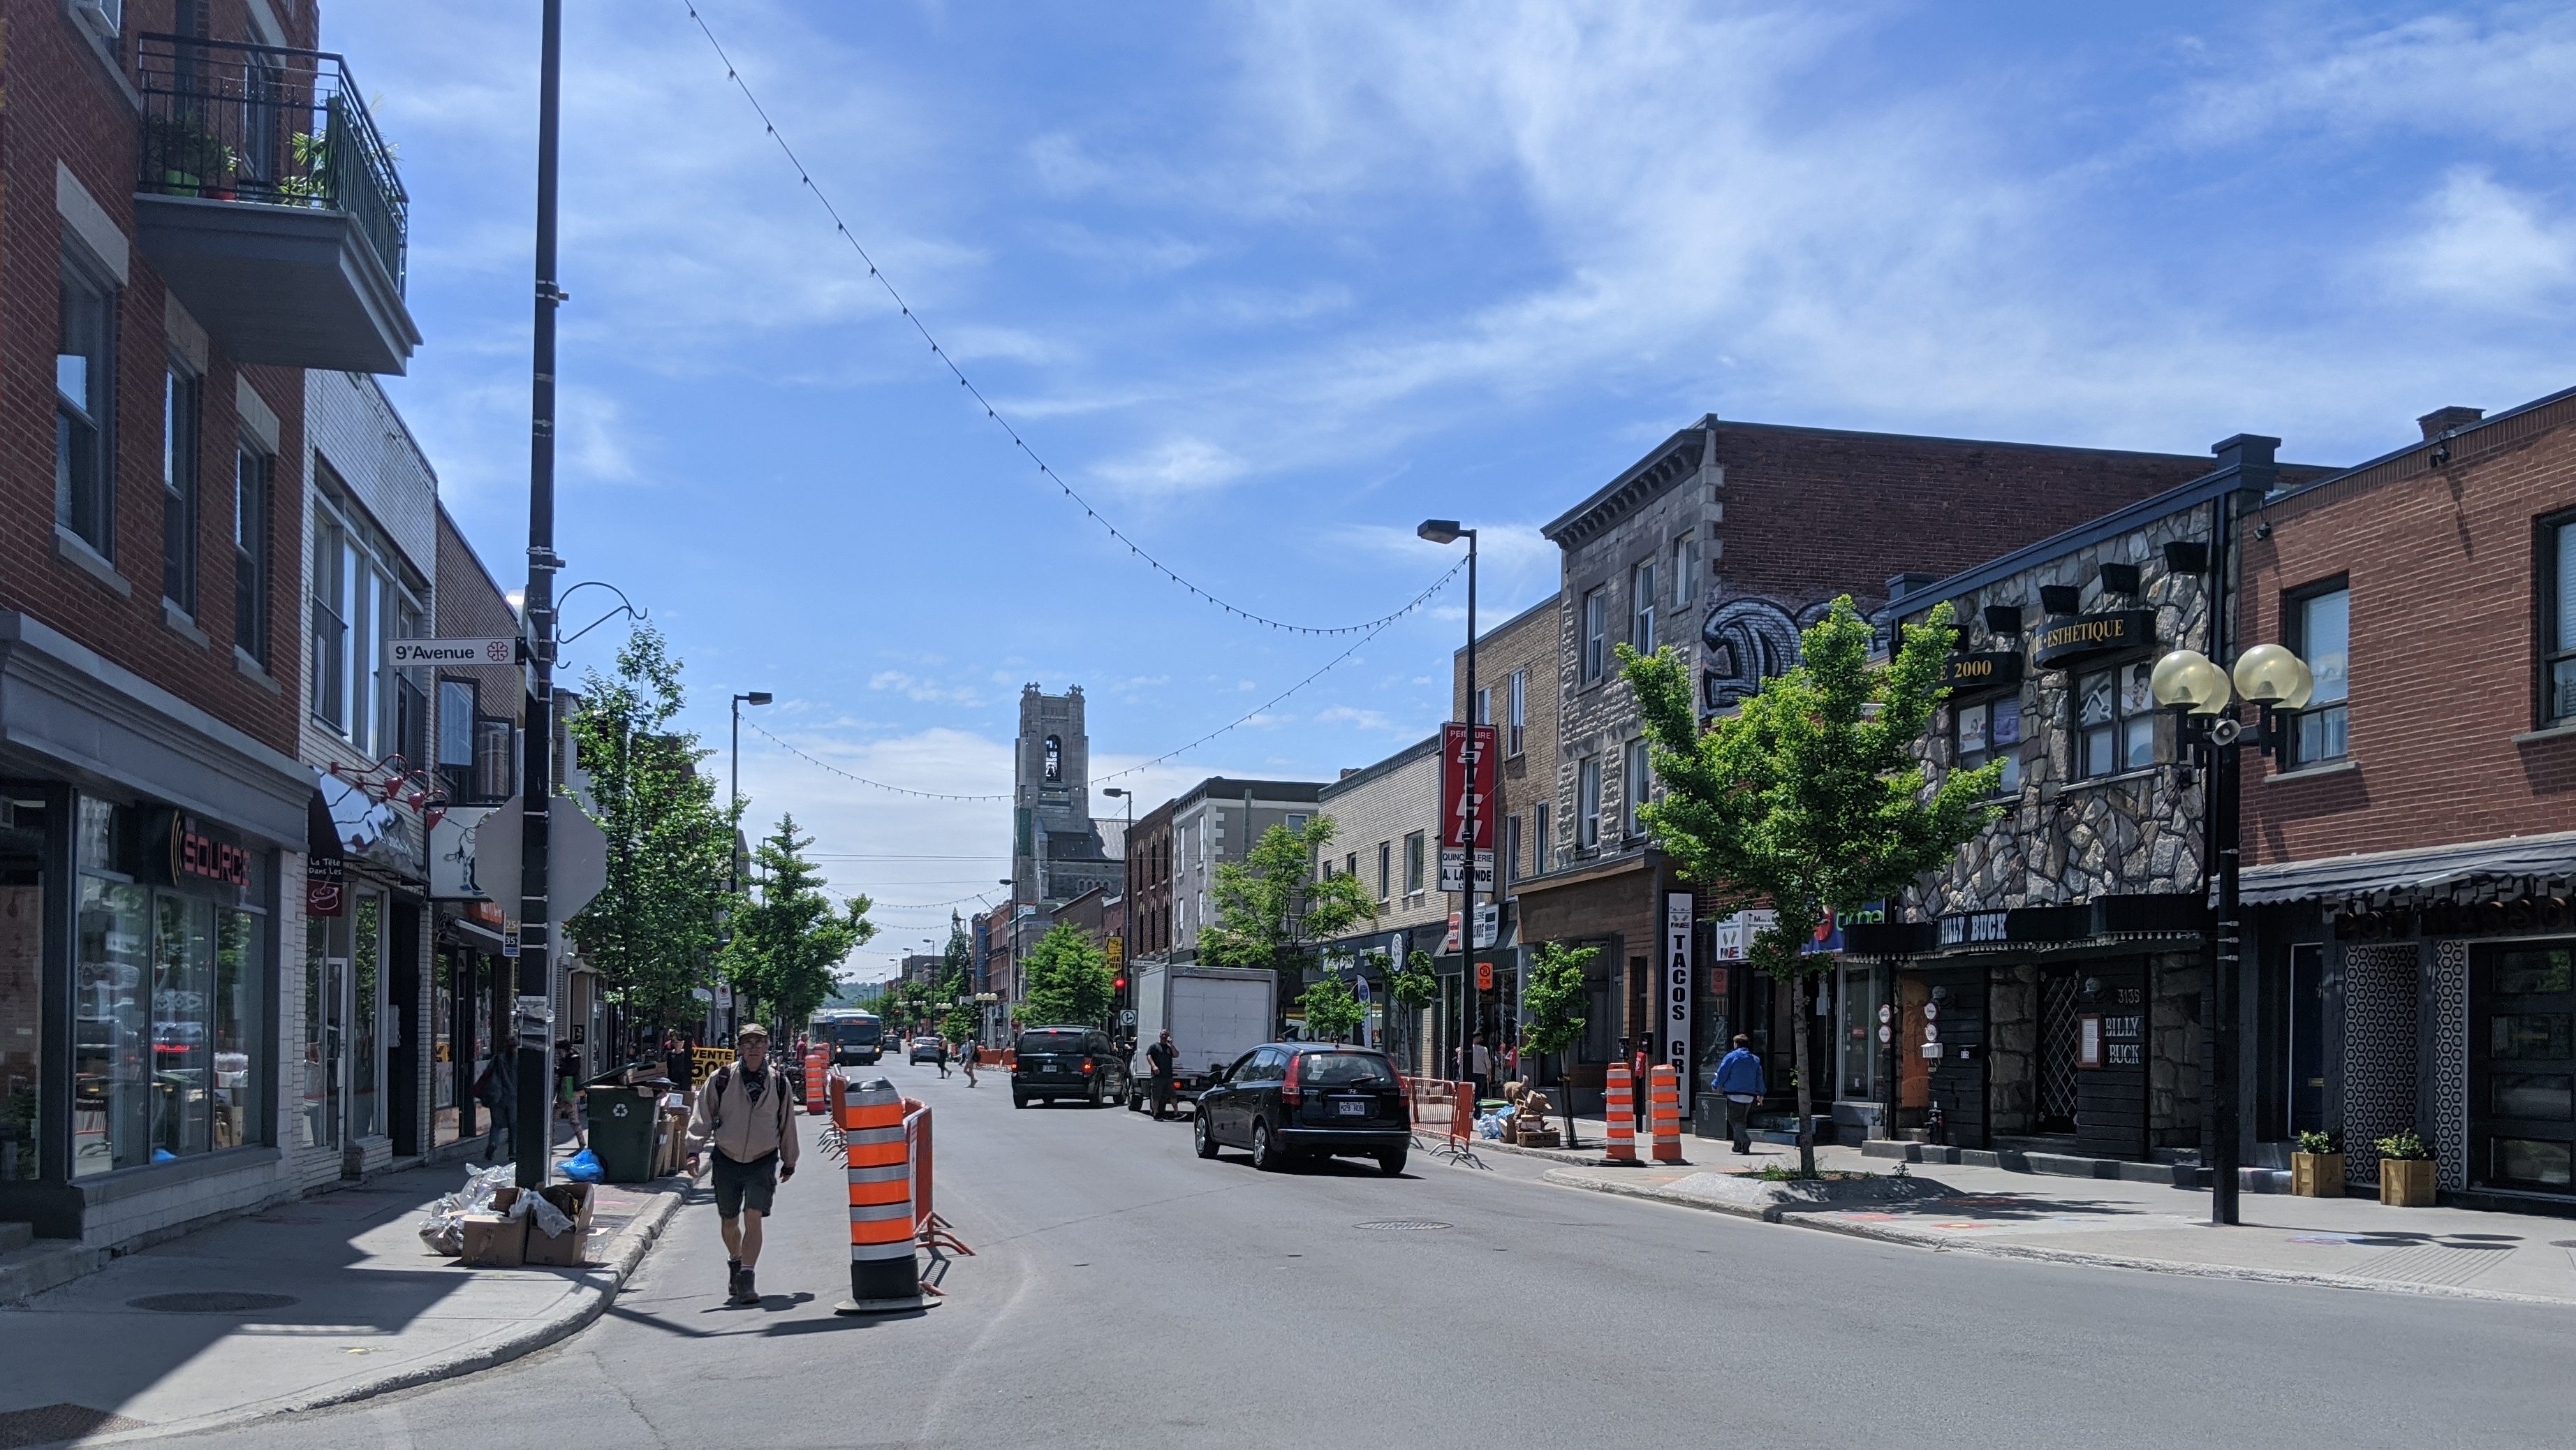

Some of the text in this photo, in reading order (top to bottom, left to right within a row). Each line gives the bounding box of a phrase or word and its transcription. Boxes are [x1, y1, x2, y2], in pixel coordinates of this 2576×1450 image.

[2047, 619, 2124, 647] ESTHÉTIQUE
[412, 645, 475, 659] Avenue
[1955, 660, 1992, 678] 2000
[184, 833, 251, 887] SOURCE
[310, 857, 320, 865] La
[329, 867, 342, 875] Les
[1442, 868, 1492, 882] A. LANDE
[1941, 913, 2008, 945] BILLY BUCK
[1672, 935, 1686, 1020] TACOS
[2117, 988, 2140, 1004] 3135
[2105, 1016, 2140, 1037] BILLY
[691, 1048, 733, 1060] VENTE
[2109, 1044, 2140, 1064] BUCK
